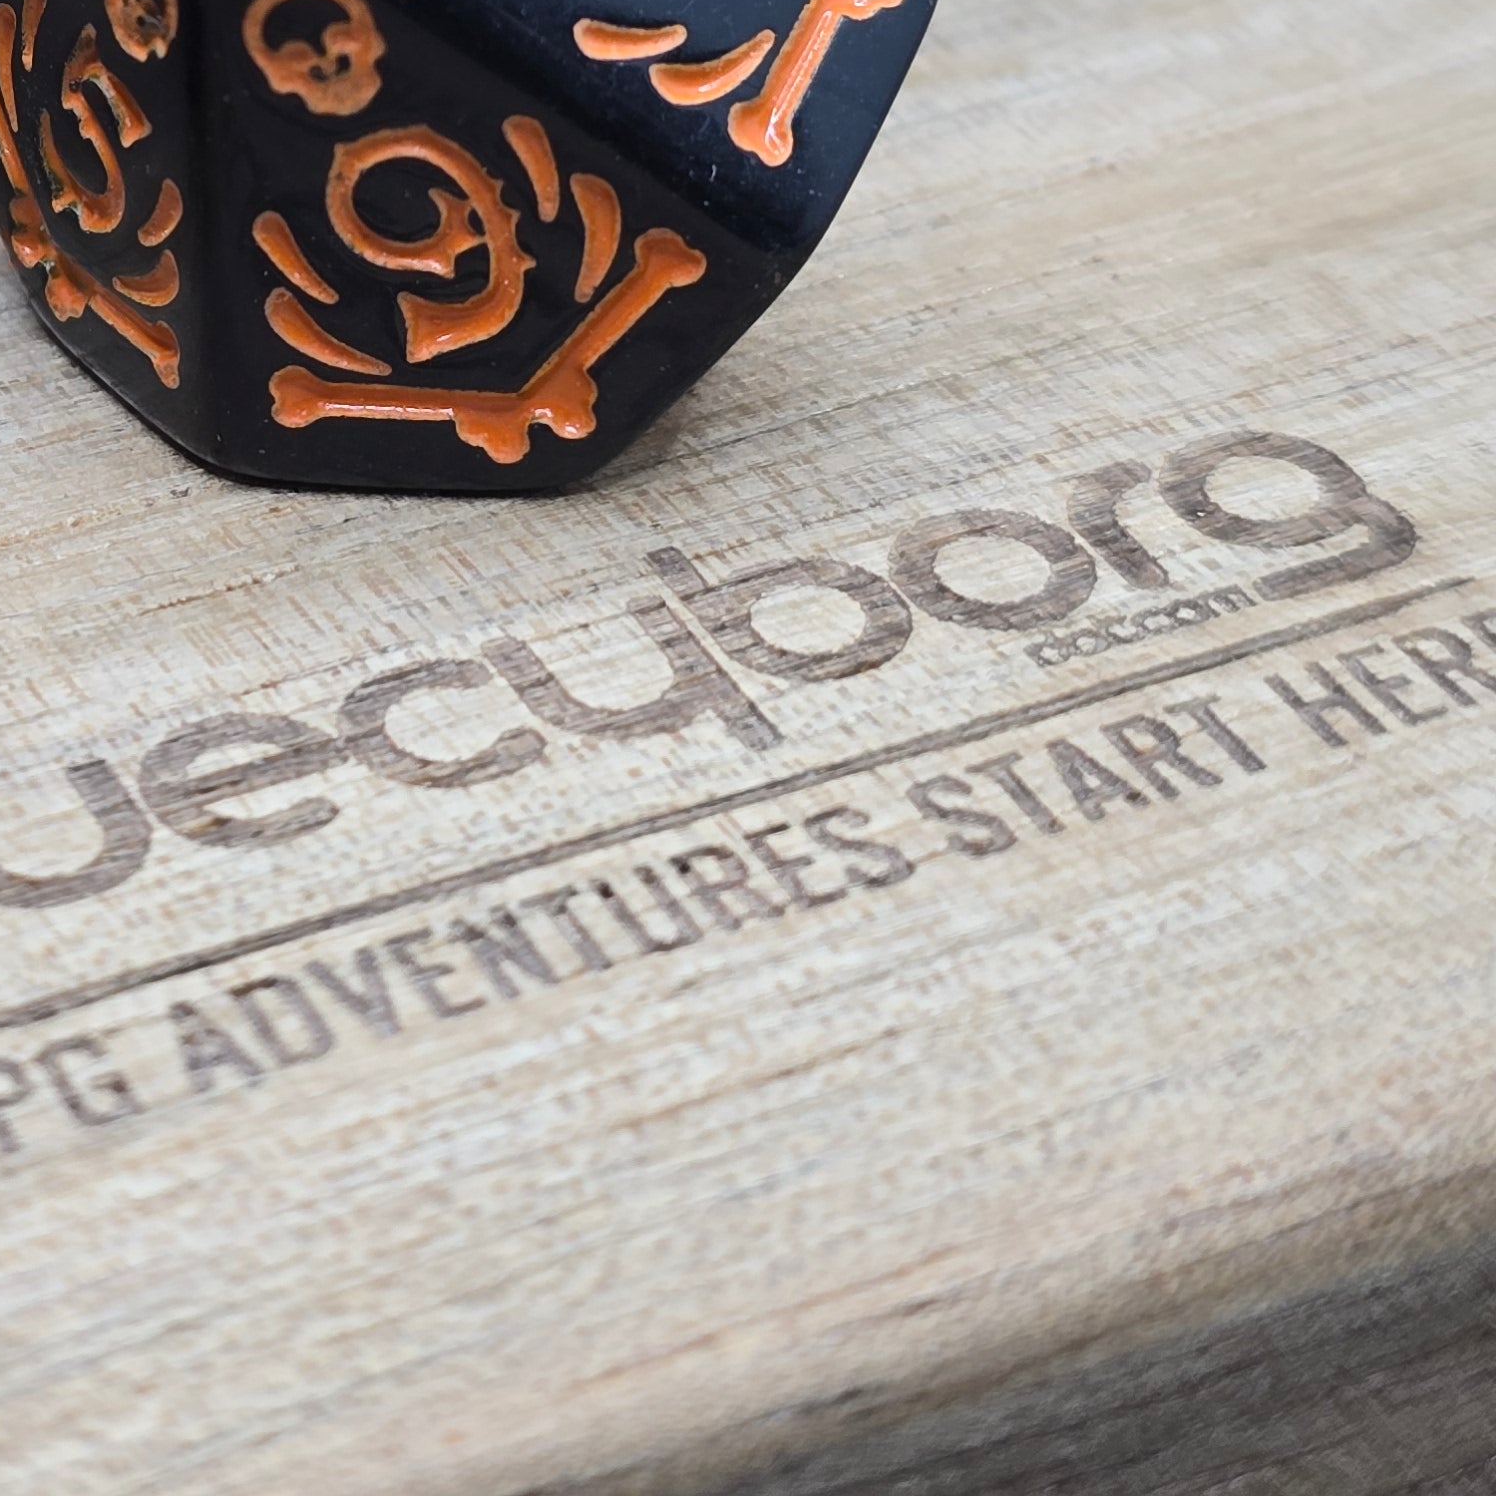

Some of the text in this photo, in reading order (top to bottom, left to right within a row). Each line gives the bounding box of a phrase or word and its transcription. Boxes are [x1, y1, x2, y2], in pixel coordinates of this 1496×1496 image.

[325, 125, 537, 364] 9
[172, 806, 916, 1092] ADVENTURES
[908, 693, 1266, 858] START
